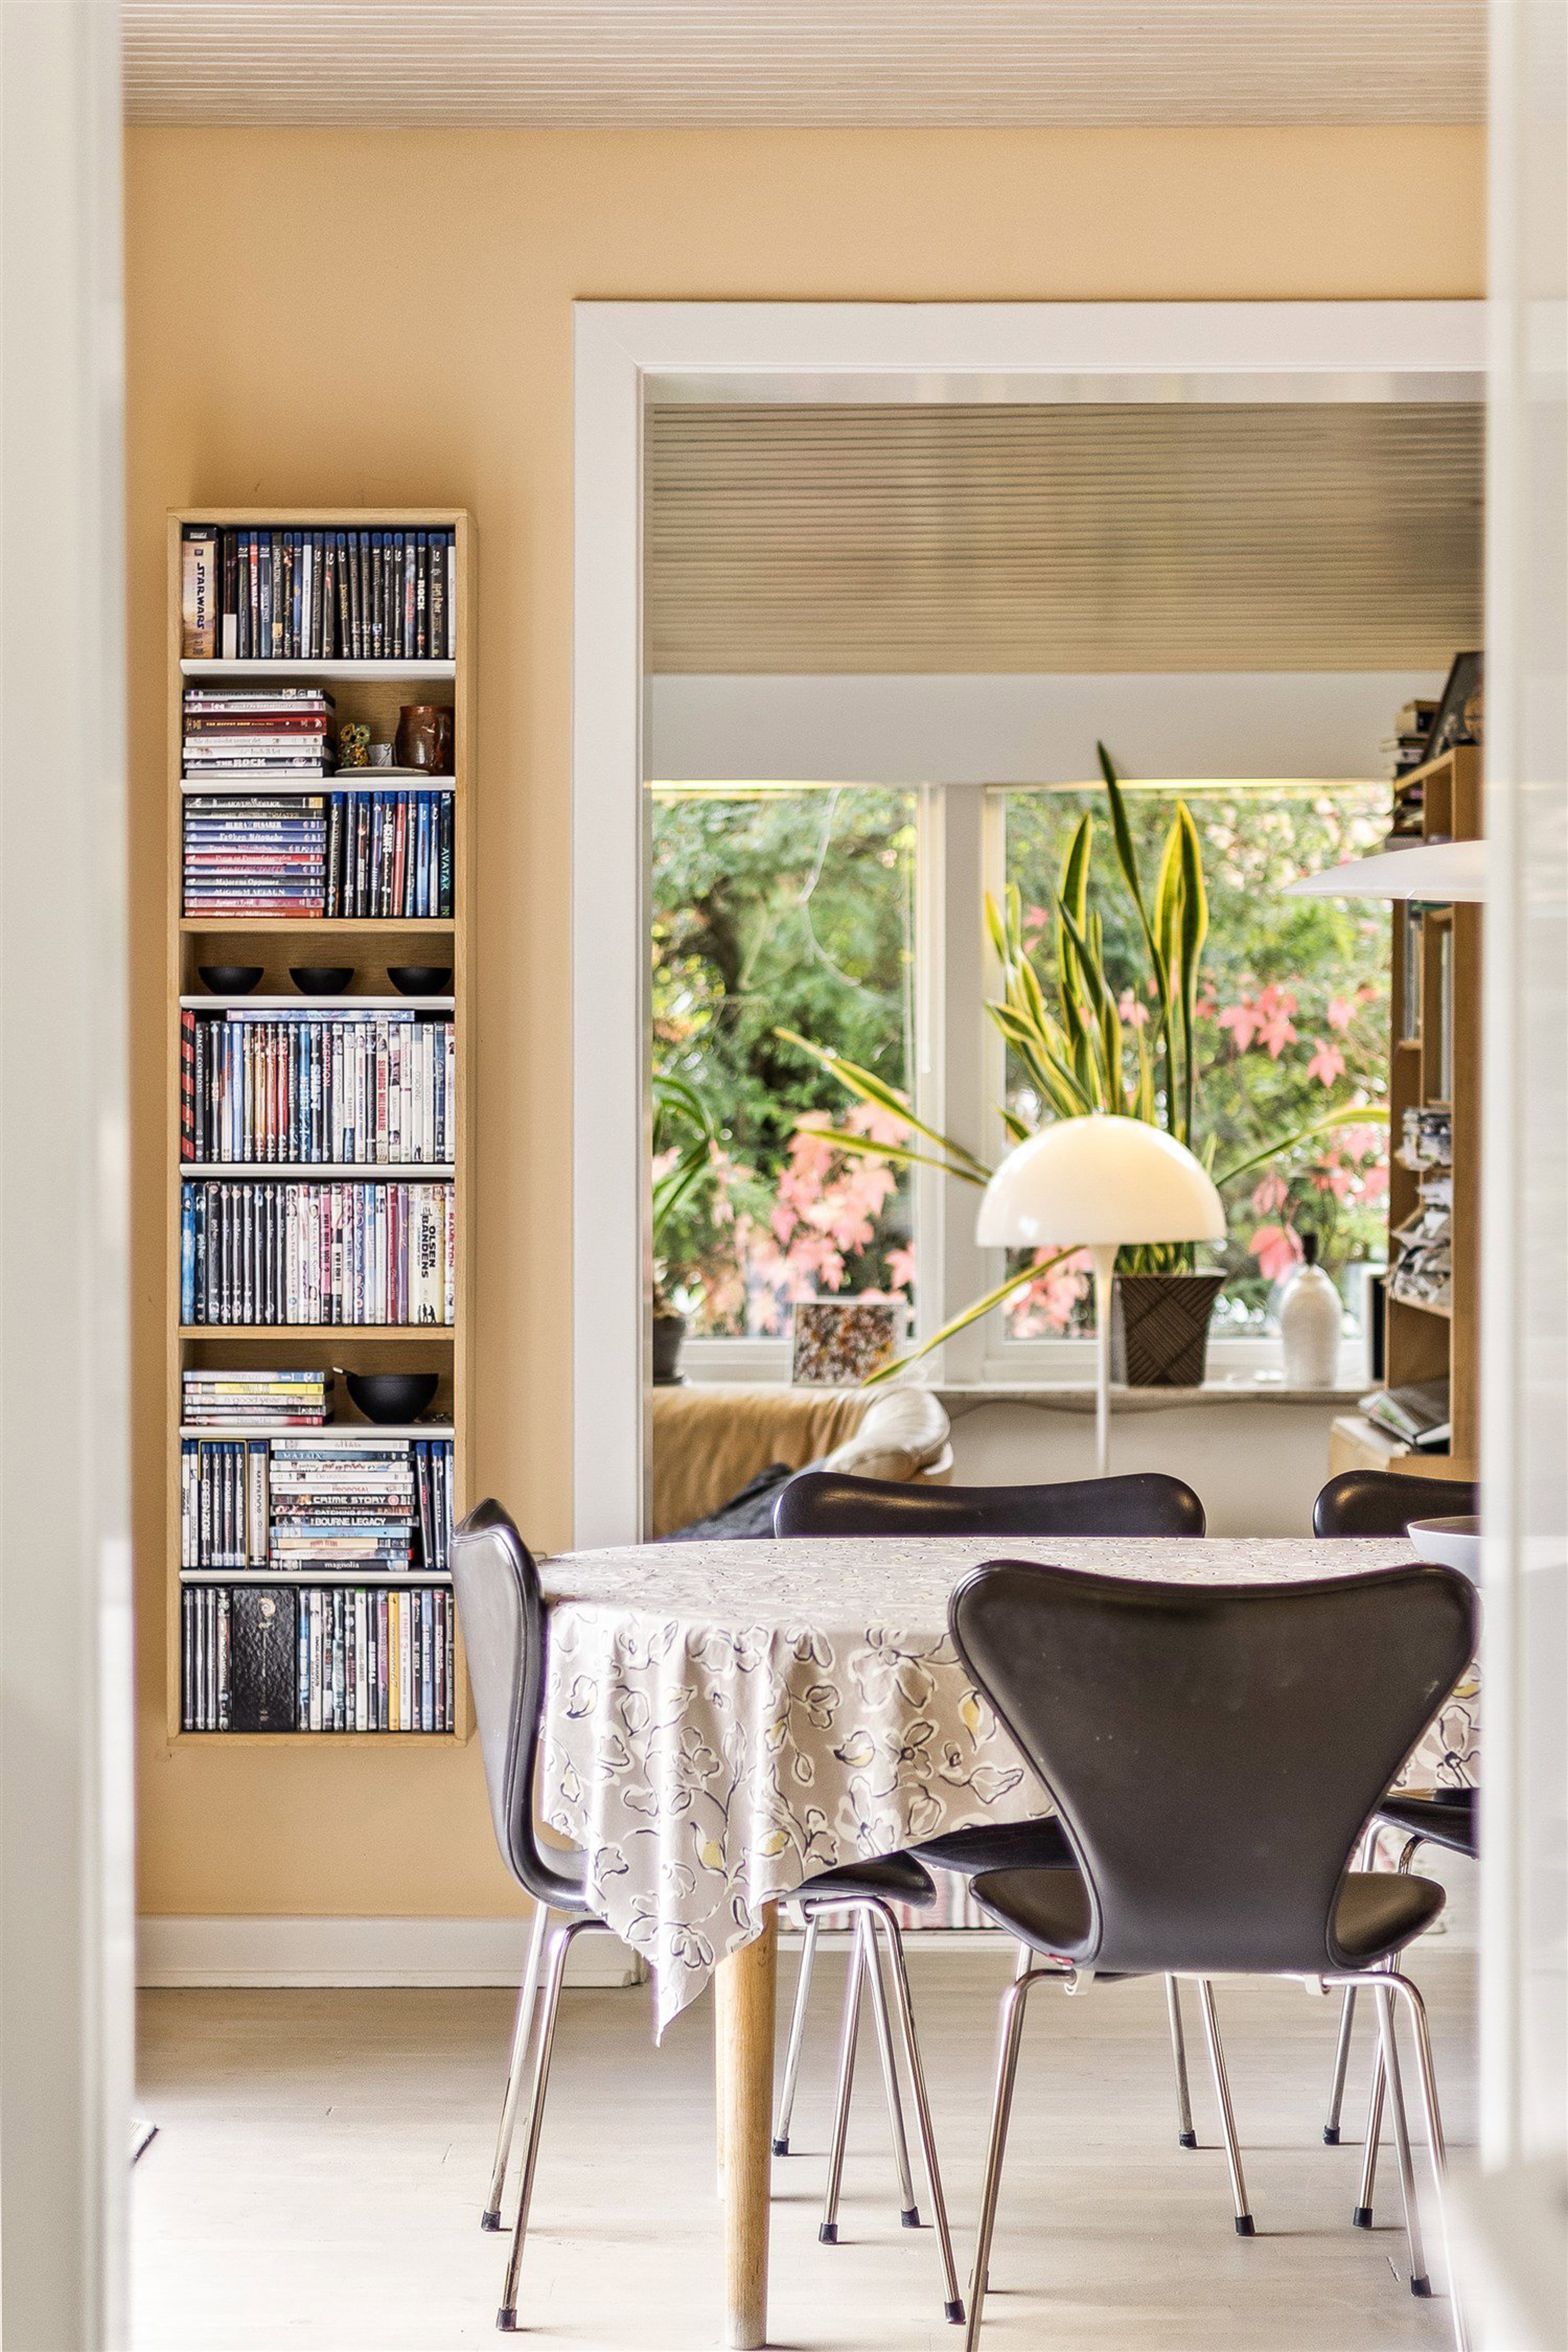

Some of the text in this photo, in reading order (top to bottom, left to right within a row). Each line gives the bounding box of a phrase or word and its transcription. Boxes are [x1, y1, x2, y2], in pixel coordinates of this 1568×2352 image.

[234, 758, 266, 767] ROCK
[441, 848, 449, 891] AVATAR
[322, 1032, 331, 1087] INCEPTION
[310, 1064, 321, 1111] SHAFT
[233, 1396, 258, 1405] good
[202, 1479, 210, 1541] GREEN ZONE
[315, 1517, 386, 1526] BOURNE LEGACY
